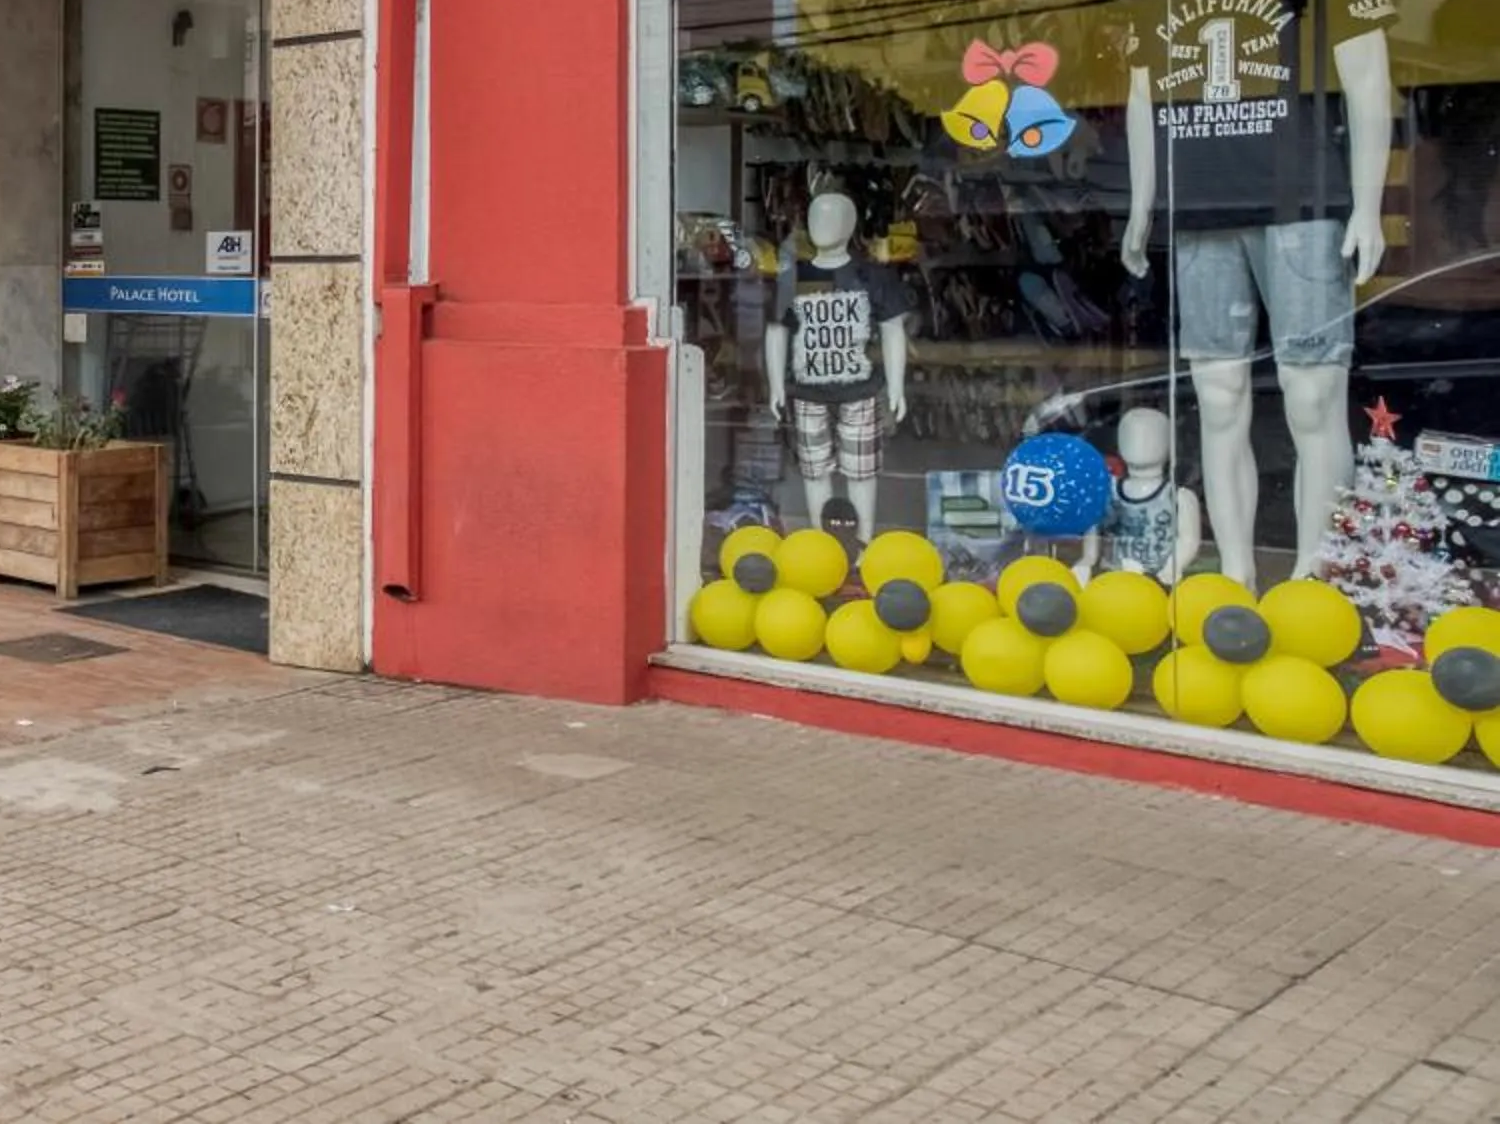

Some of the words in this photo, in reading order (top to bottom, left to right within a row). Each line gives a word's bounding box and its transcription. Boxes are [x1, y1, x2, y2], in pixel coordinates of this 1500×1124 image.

[1240, 31, 1280, 56] TEAM
[1156, 62, 1205, 92] VICTORY
[1238, 59, 1291, 82] WINNER
[1157, 106, 1189, 126] SAN
[1193, 98, 1288, 124] FRANCISCO
[1215, 119, 1274, 137] COLLEGE
[110, 285, 156, 302] PALACE
[157, 287, 201, 303] HOTEL
[803, 297, 860, 325] ROCK
[803, 325, 859, 350] COOL
[805, 349, 862, 377] KIDS
[1005, 462, 1055, 507] 15
